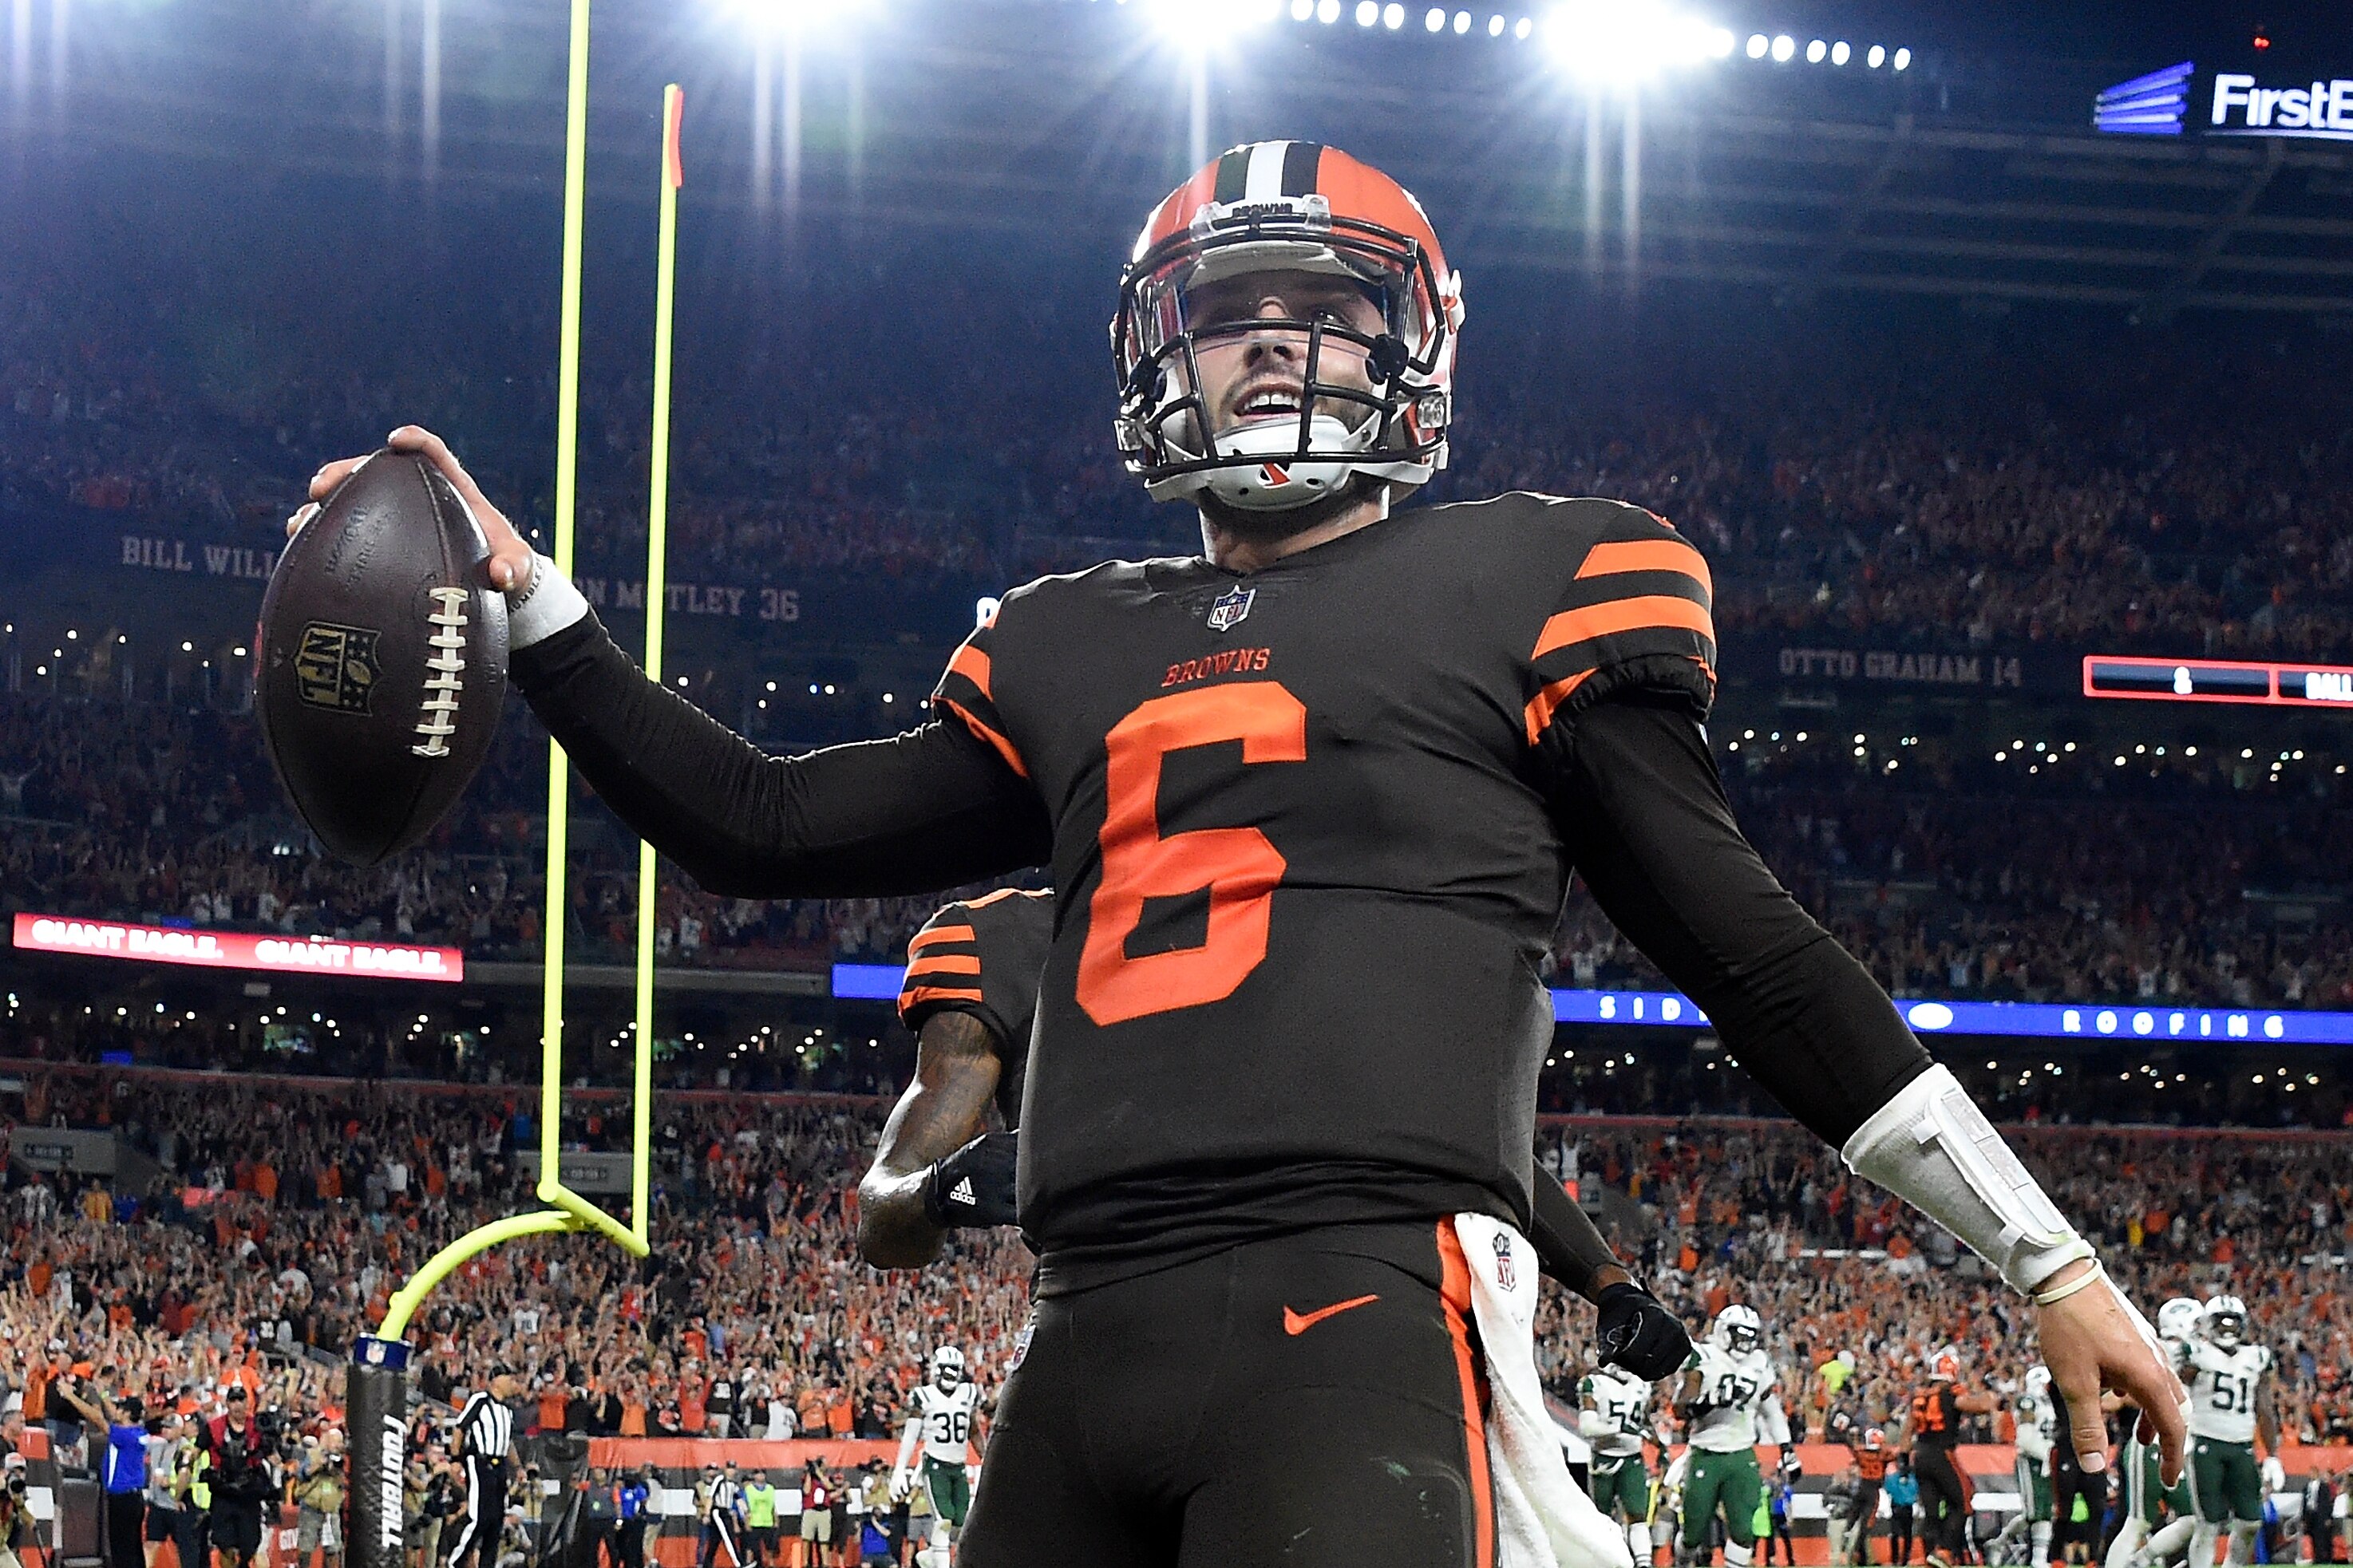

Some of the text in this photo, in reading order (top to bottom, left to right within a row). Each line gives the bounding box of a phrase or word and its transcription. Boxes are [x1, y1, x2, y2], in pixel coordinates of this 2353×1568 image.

[2212, 73, 2353, 130] FirstE
[121, 535, 192, 572] BILL
[615, 581, 745, 616] MTLEY
[760, 588, 798, 622] 36
[299, 627, 346, 705] NFL
[1161, 647, 1271, 688] BROWNS
[1780, 649, 2022, 687] OTTO GRAHAM 14
[1075, 681, 1307, 1027] 6
[32, 918, 126, 950] GIANT
[255, 939, 351, 968] GIANT
[1599, 995, 1708, 1022] SID
[2062, 1009, 2284, 1038] ROOFING
[950, 1191, 976, 1206] adidas
[2211, 1370, 2248, 1414] 51
[932, 1411, 969, 1444] 36
[382, 1413, 407, 1549] FOOTBALL
